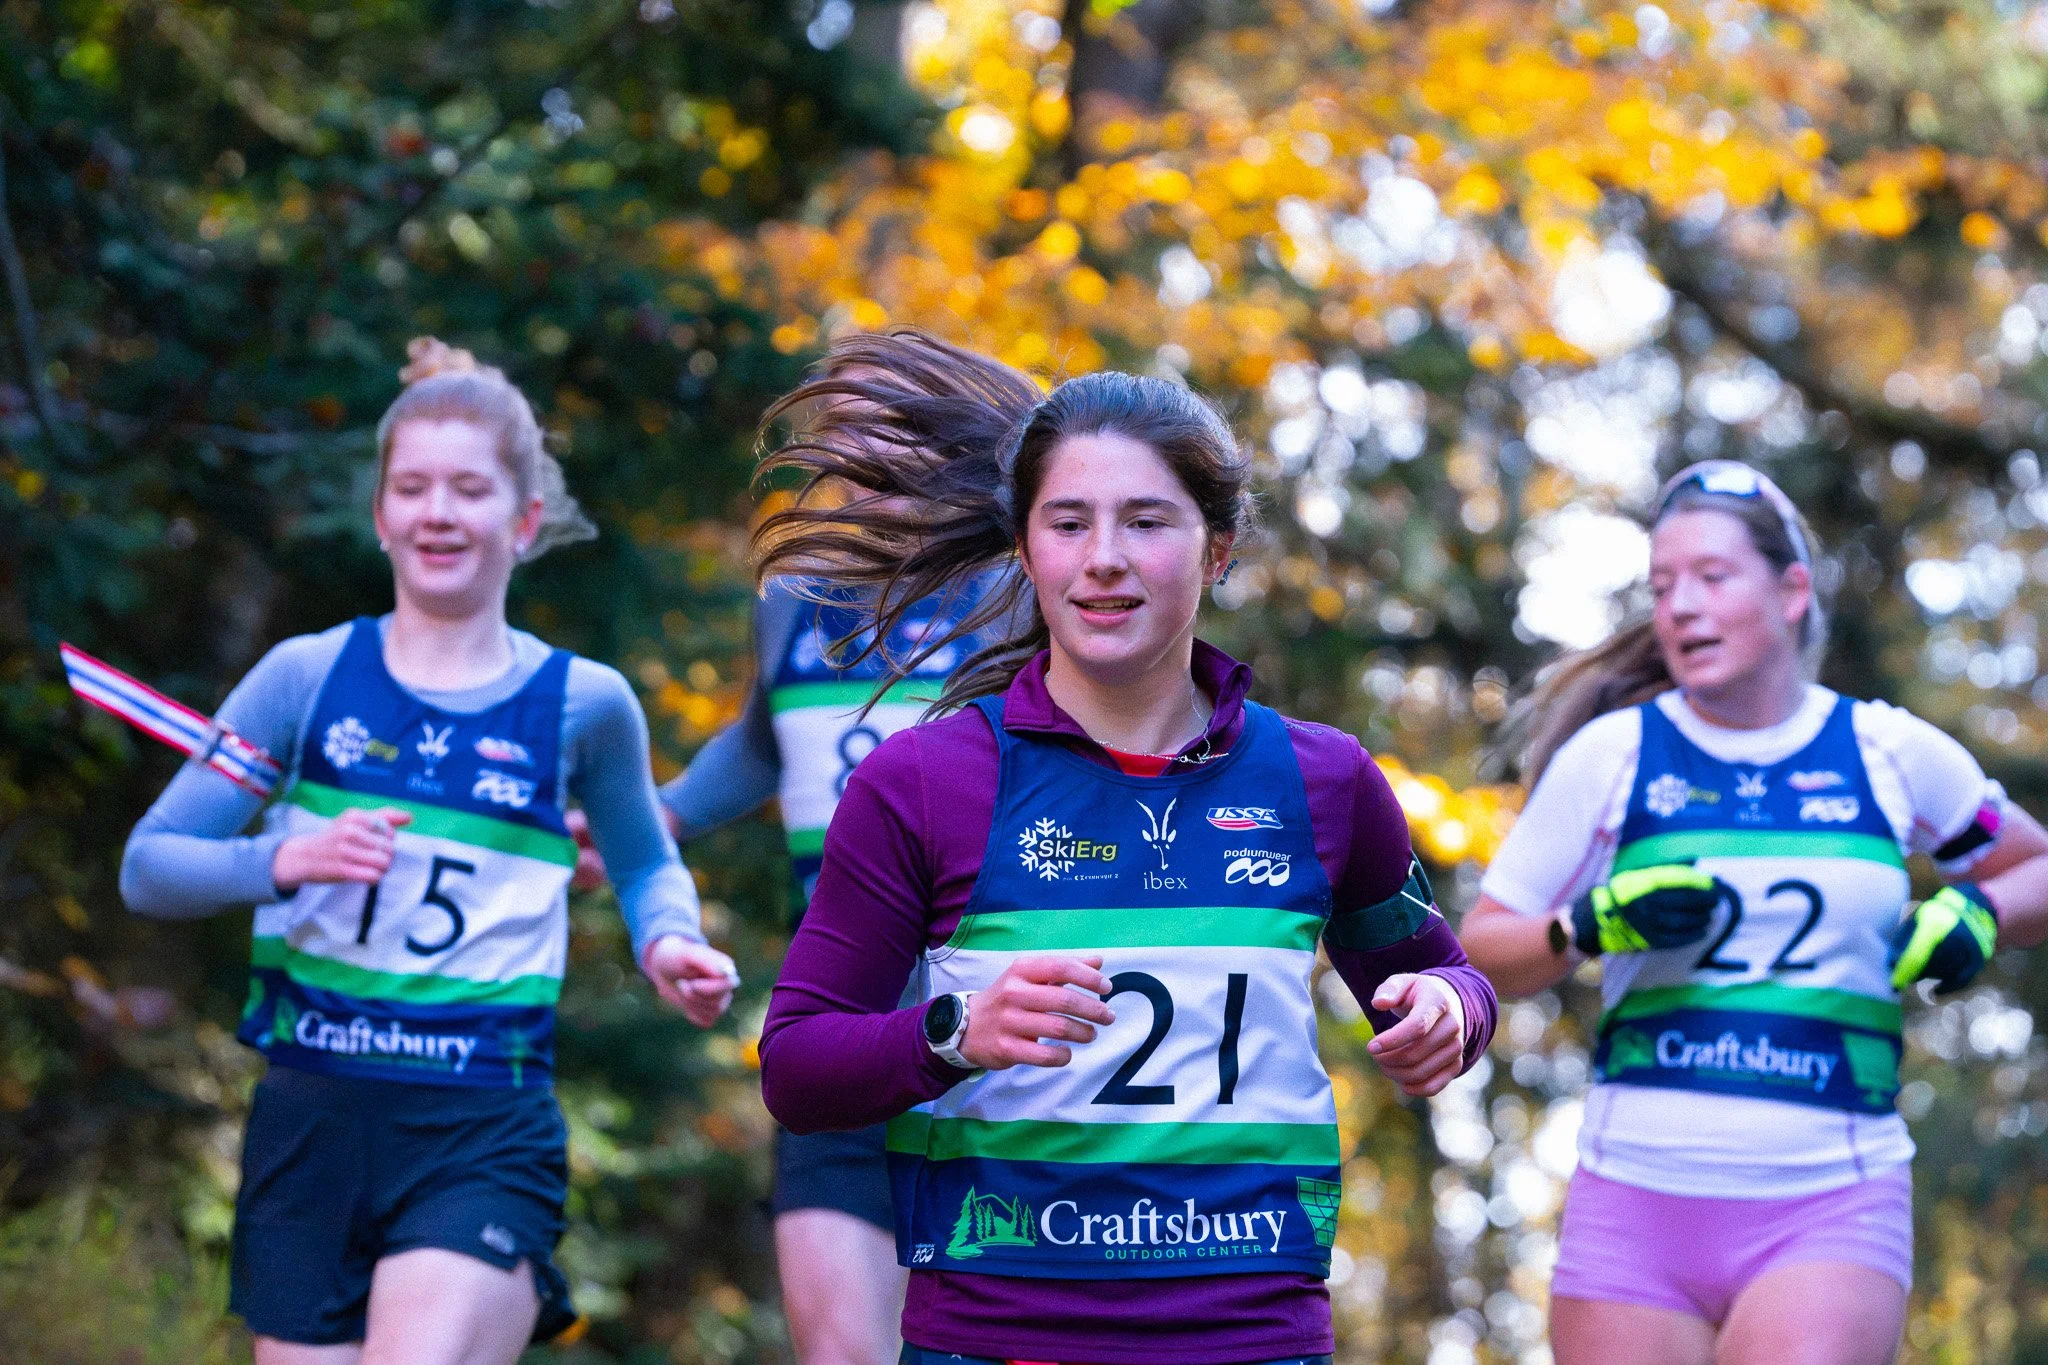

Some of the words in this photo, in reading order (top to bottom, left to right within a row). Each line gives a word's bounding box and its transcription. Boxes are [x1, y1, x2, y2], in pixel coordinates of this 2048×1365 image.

[1207, 807, 1281, 822] USSA
[1038, 839, 1117, 862] SkiErg
[1223, 847, 1292, 862] podiumwear
[1143, 871, 1188, 890] ibex
[356, 855, 476, 957] 15
[1696, 875, 1824, 972] 22
[1090, 971, 1249, 1105] 21
[1040, 1198, 1288, 1253] Craftsbury
[1104, 1248, 1188, 1260] OUTDOOR
[1197, 1244, 1263, 1257] CENTER
